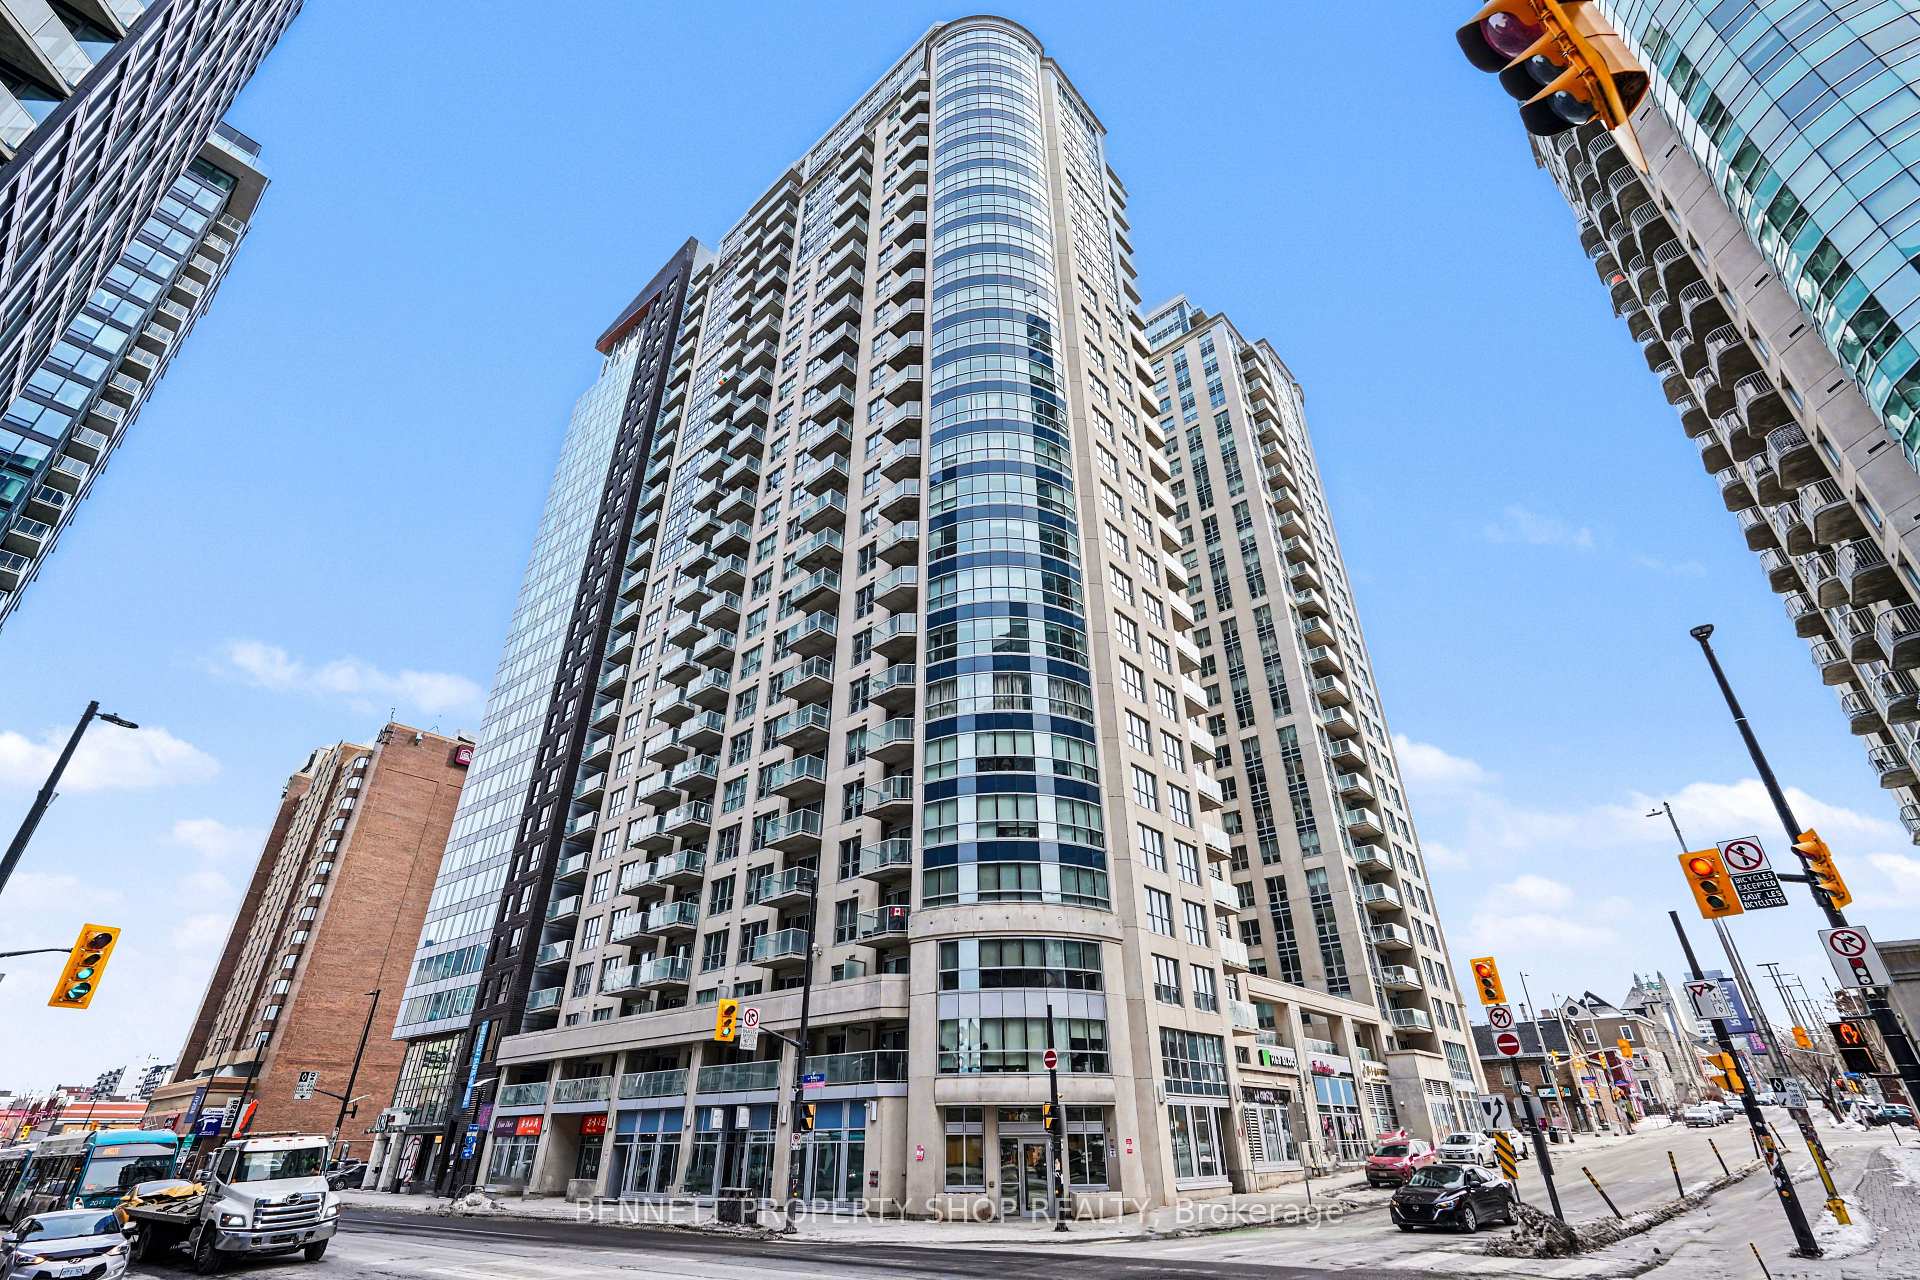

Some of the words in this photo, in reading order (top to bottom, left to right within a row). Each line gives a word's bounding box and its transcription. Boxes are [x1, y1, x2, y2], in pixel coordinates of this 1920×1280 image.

[1734, 872, 1774, 884] BICYCLES
[1738, 880, 1777, 891] EXCEPTED
[1741, 893, 1762, 901] SAUF
[1766, 890, 1782, 898] LES
[1743, 897, 1786, 909] BICYCLETTES
